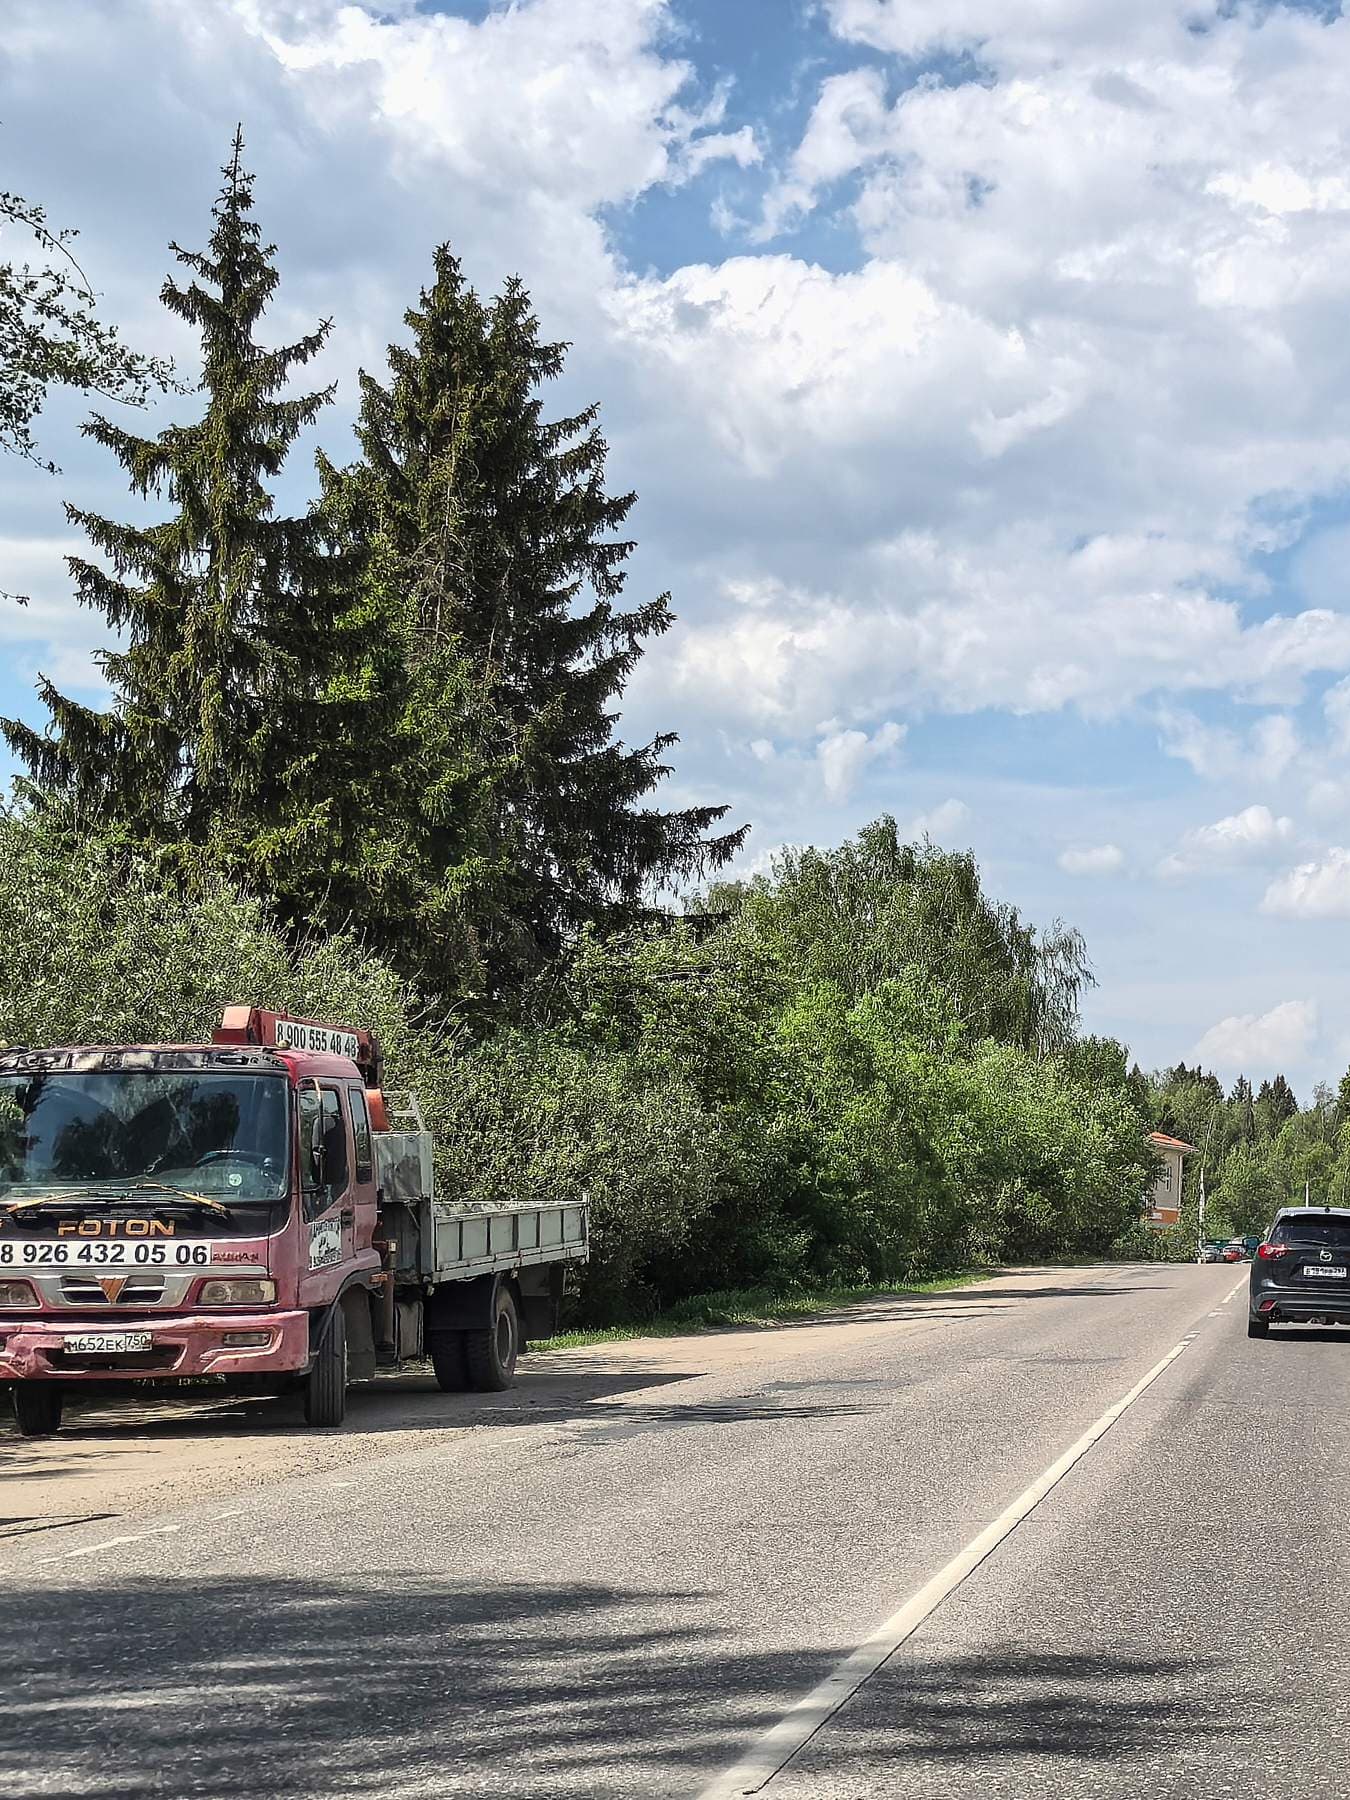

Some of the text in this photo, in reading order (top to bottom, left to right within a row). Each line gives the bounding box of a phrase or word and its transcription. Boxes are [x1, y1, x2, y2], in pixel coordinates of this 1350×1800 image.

[277, 1023, 284, 1042] 8
[287, 1025, 306, 1049] 900
[309, 1029, 327, 1051] 555
[57, 1219, 176, 1237] FOTON
[0, 1244, 208, 1265] 8 926 432 05 06
